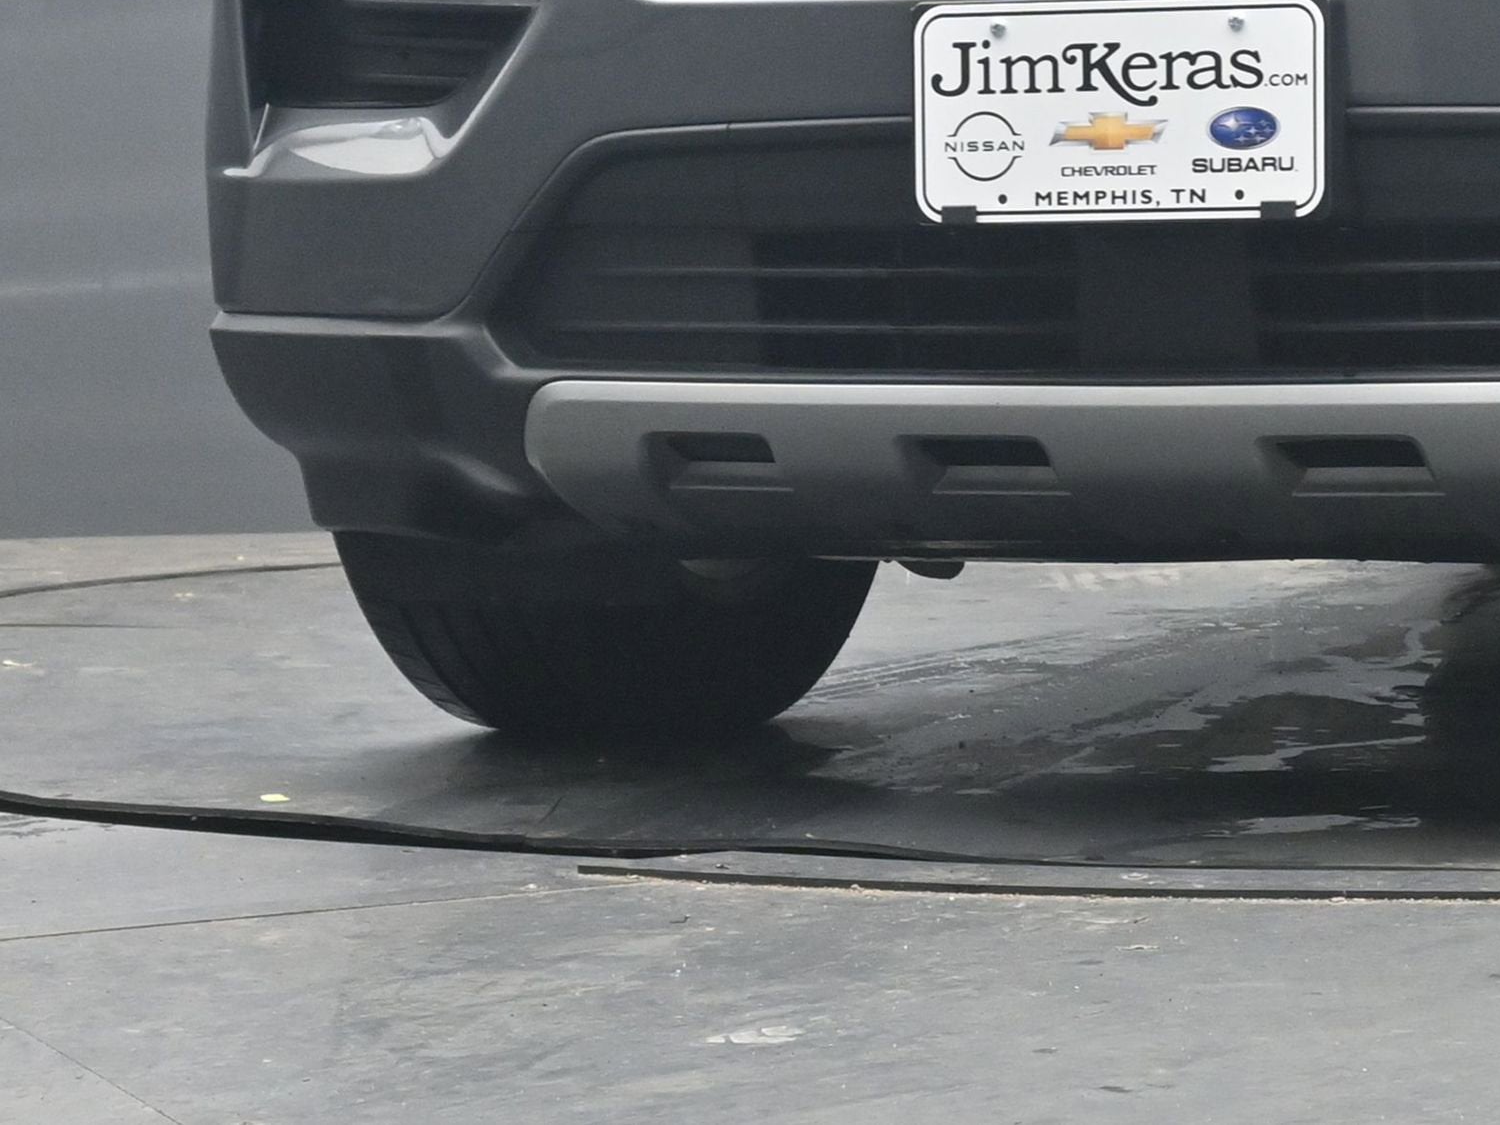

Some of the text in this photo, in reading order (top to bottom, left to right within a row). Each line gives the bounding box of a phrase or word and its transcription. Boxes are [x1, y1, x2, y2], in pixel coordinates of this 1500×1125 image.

[944, 139, 1025, 153] NISSAN
[1061, 164, 1158, 177] CHEVROLET
[1191, 156, 1296, 173] SUBARU
[1035, 188, 1207, 207] MEMPHIS, TN
